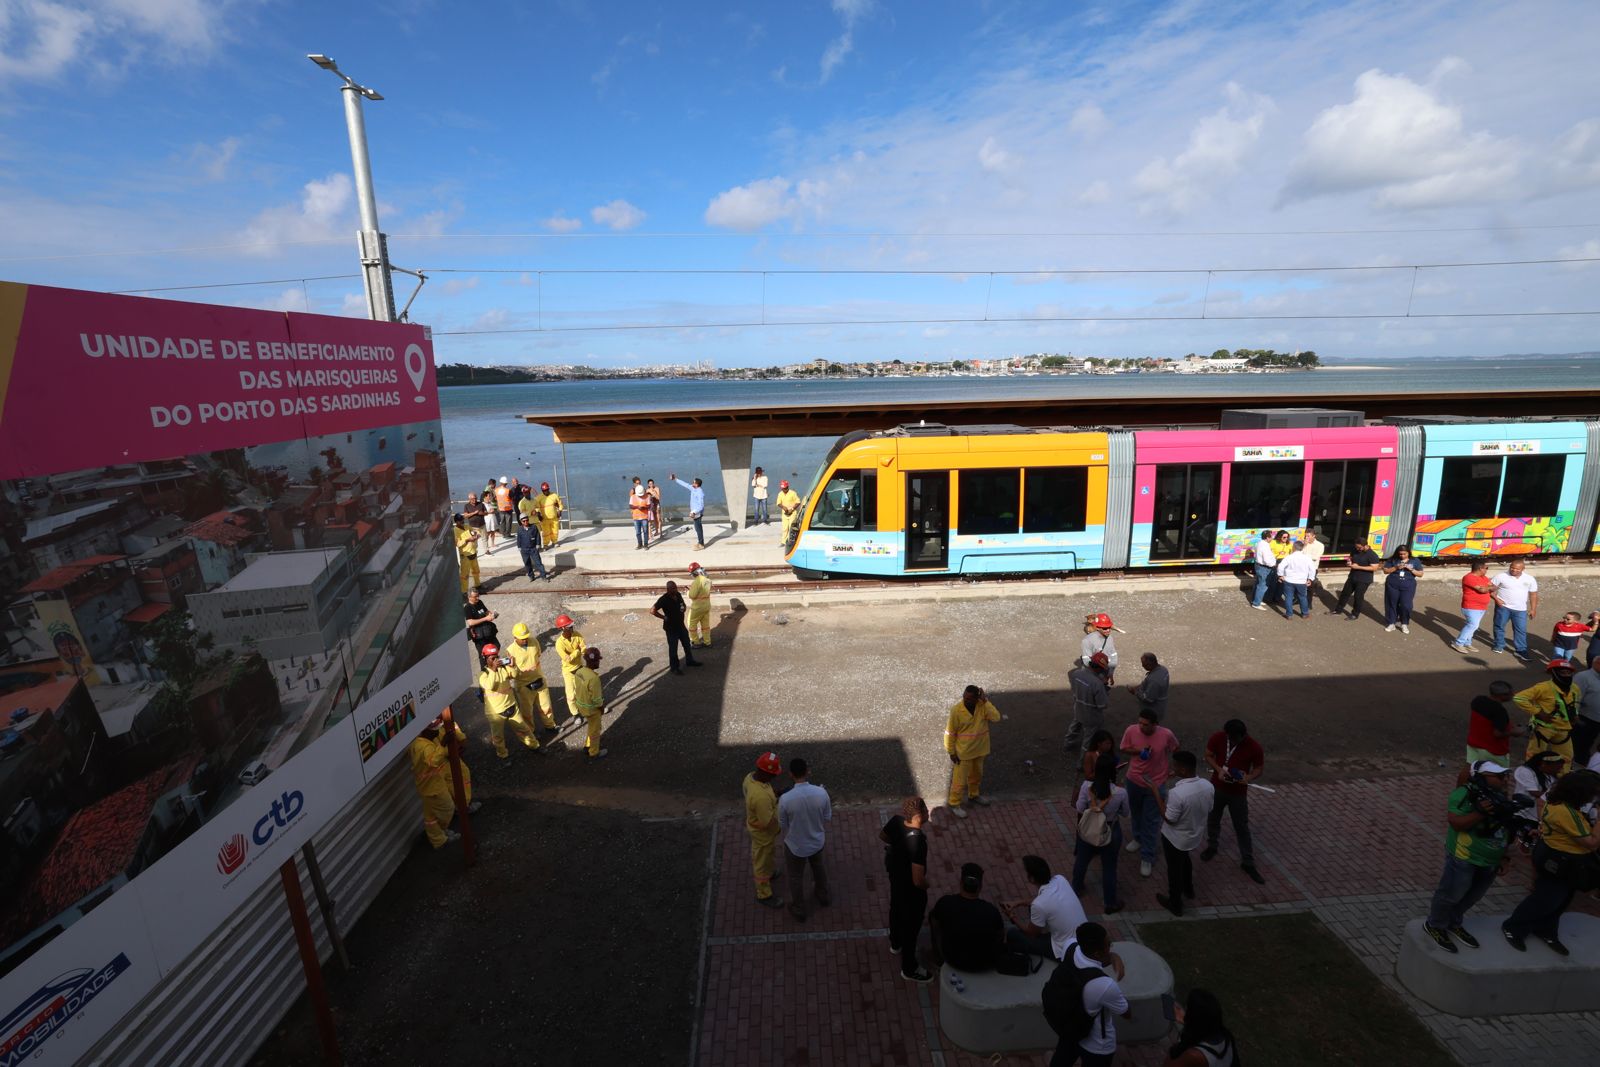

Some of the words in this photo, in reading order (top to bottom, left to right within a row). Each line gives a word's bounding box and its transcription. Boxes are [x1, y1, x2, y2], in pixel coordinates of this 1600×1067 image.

[79, 332, 215, 359] UNIDADE
[221, 339, 252, 361] DE
[257, 341, 395, 362] BENEFICIAMENTO
[240, 370, 282, 390] DAS
[287, 368, 397, 389] MARISQUEIRAS
[150, 405, 192, 428] DO
[200, 400, 275, 423] PORTO
[281, 396, 318, 416] DAS
[321, 391, 401, 412] SARDINHAS
[358, 700, 401, 741] GOVERNO
[401, 690, 414, 705] DA
[360, 702, 416, 763] BAHIA
[0, 963, 117, 1067] MOBILIDADE
